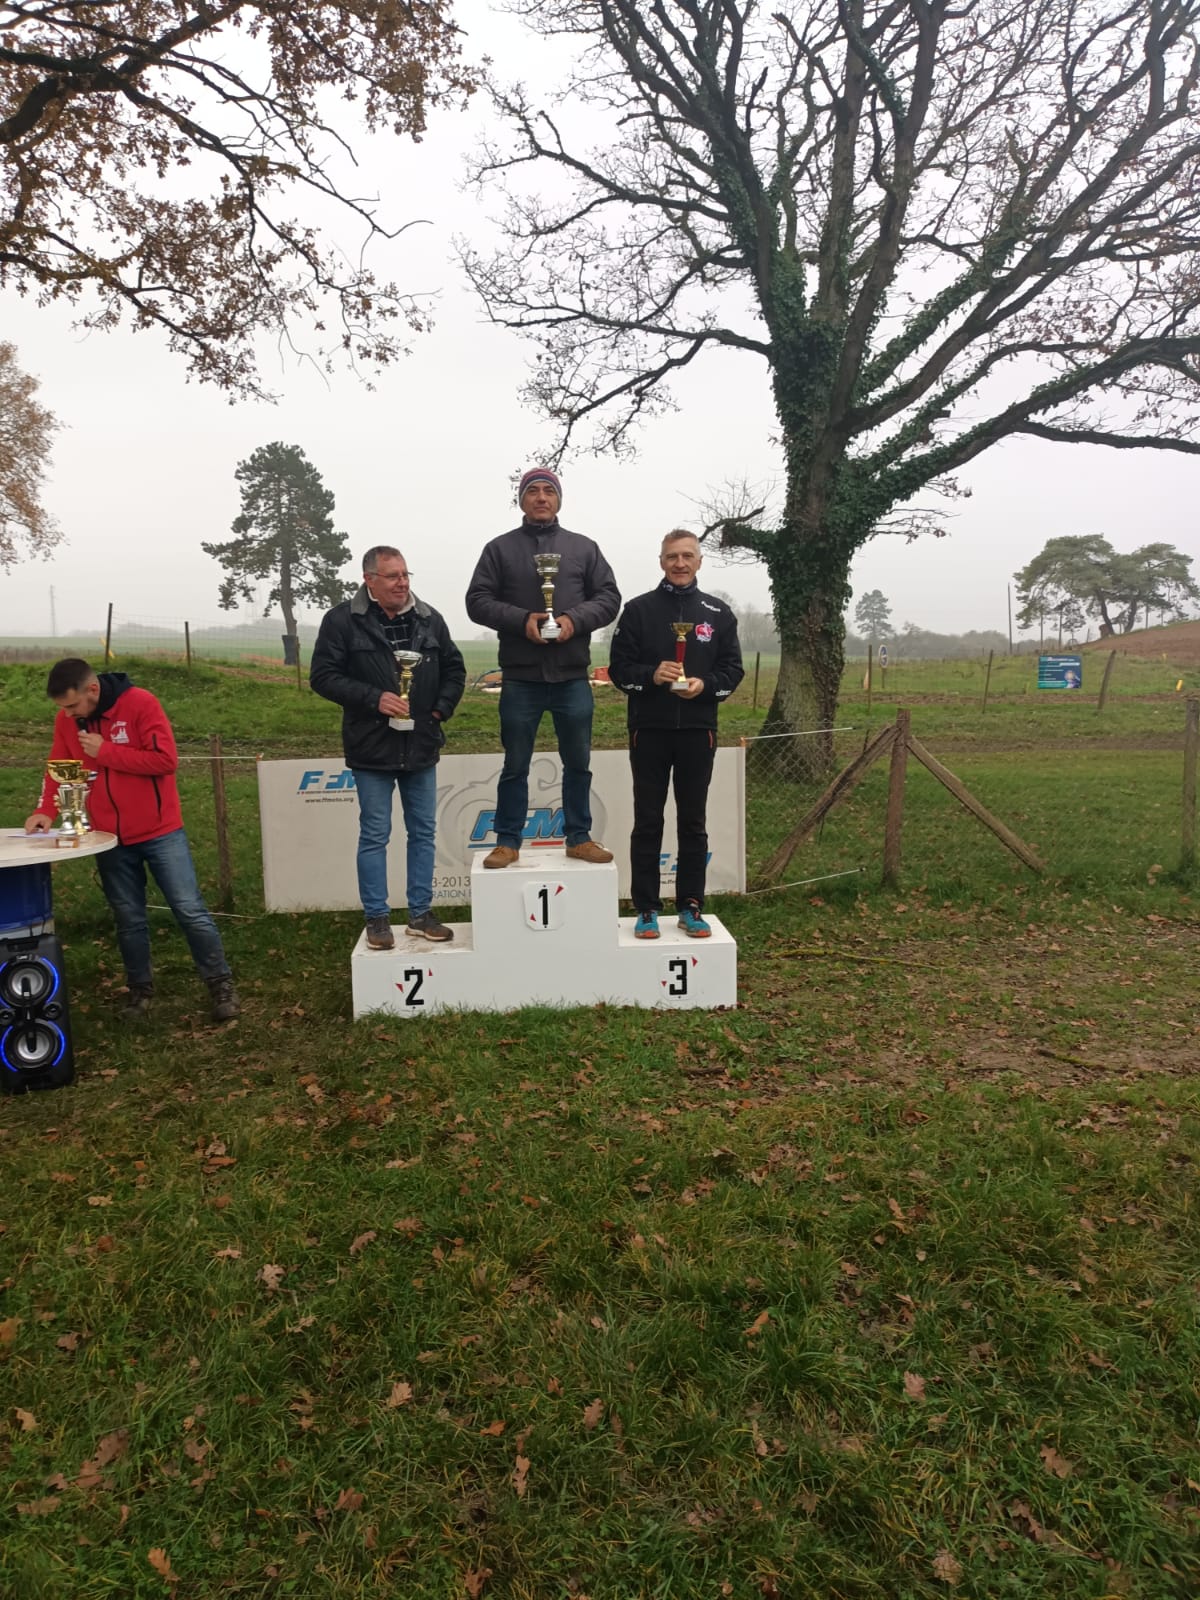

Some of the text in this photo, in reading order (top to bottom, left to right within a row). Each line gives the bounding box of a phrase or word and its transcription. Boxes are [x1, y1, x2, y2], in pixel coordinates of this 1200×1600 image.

[538, 888, 548, 926] 1
[404, 969, 425, 1006] 2
[669, 959, 687, 995] 3
